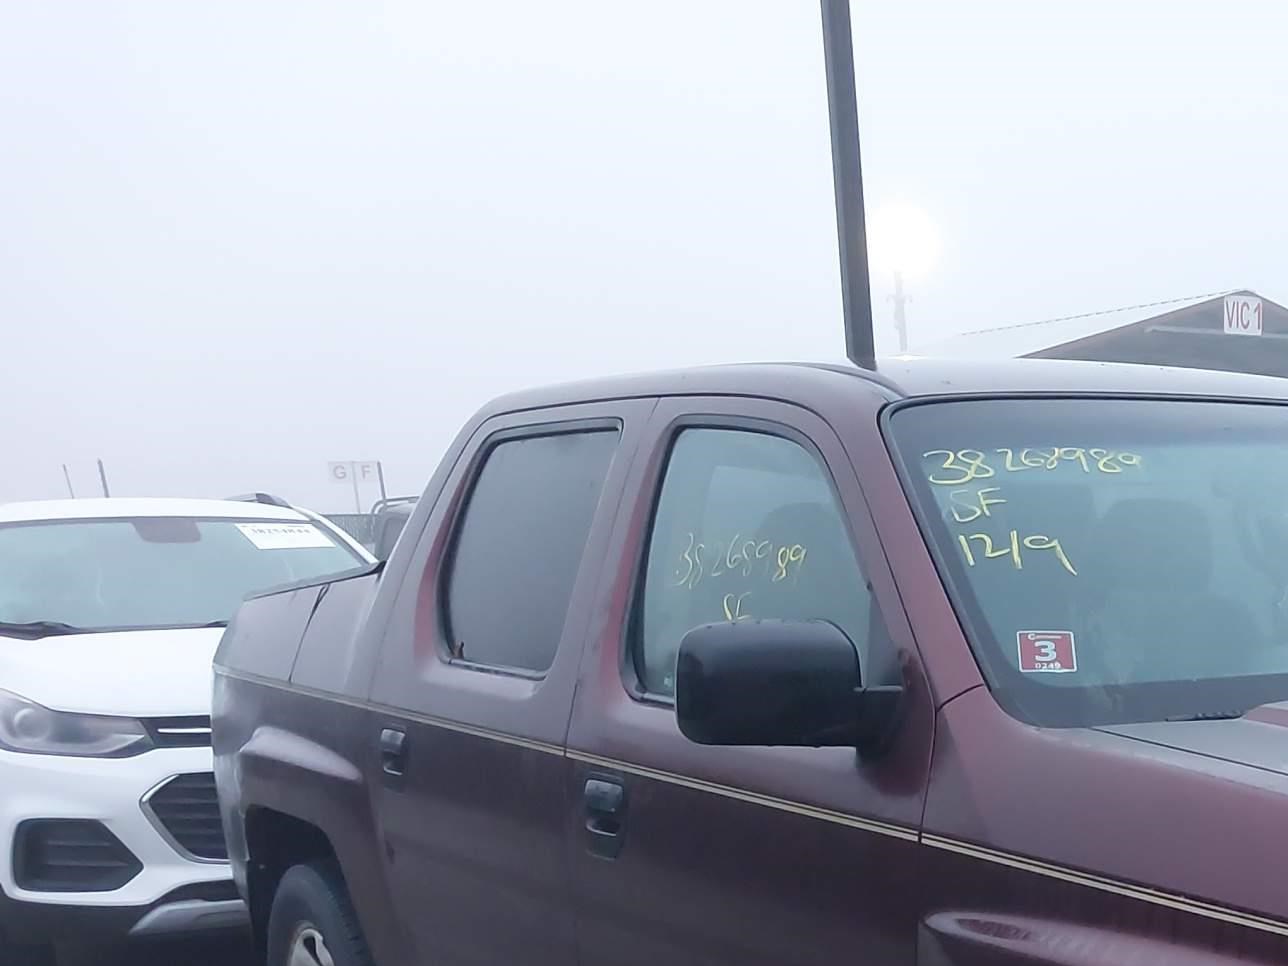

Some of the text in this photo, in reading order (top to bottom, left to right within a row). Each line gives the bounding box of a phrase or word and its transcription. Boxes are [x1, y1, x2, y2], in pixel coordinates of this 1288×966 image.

[1225, 300, 1262, 331] VIC 1
[332, 464, 347, 480] G
[361, 464, 371, 480] F
[1034, 640, 1057, 662] 3
